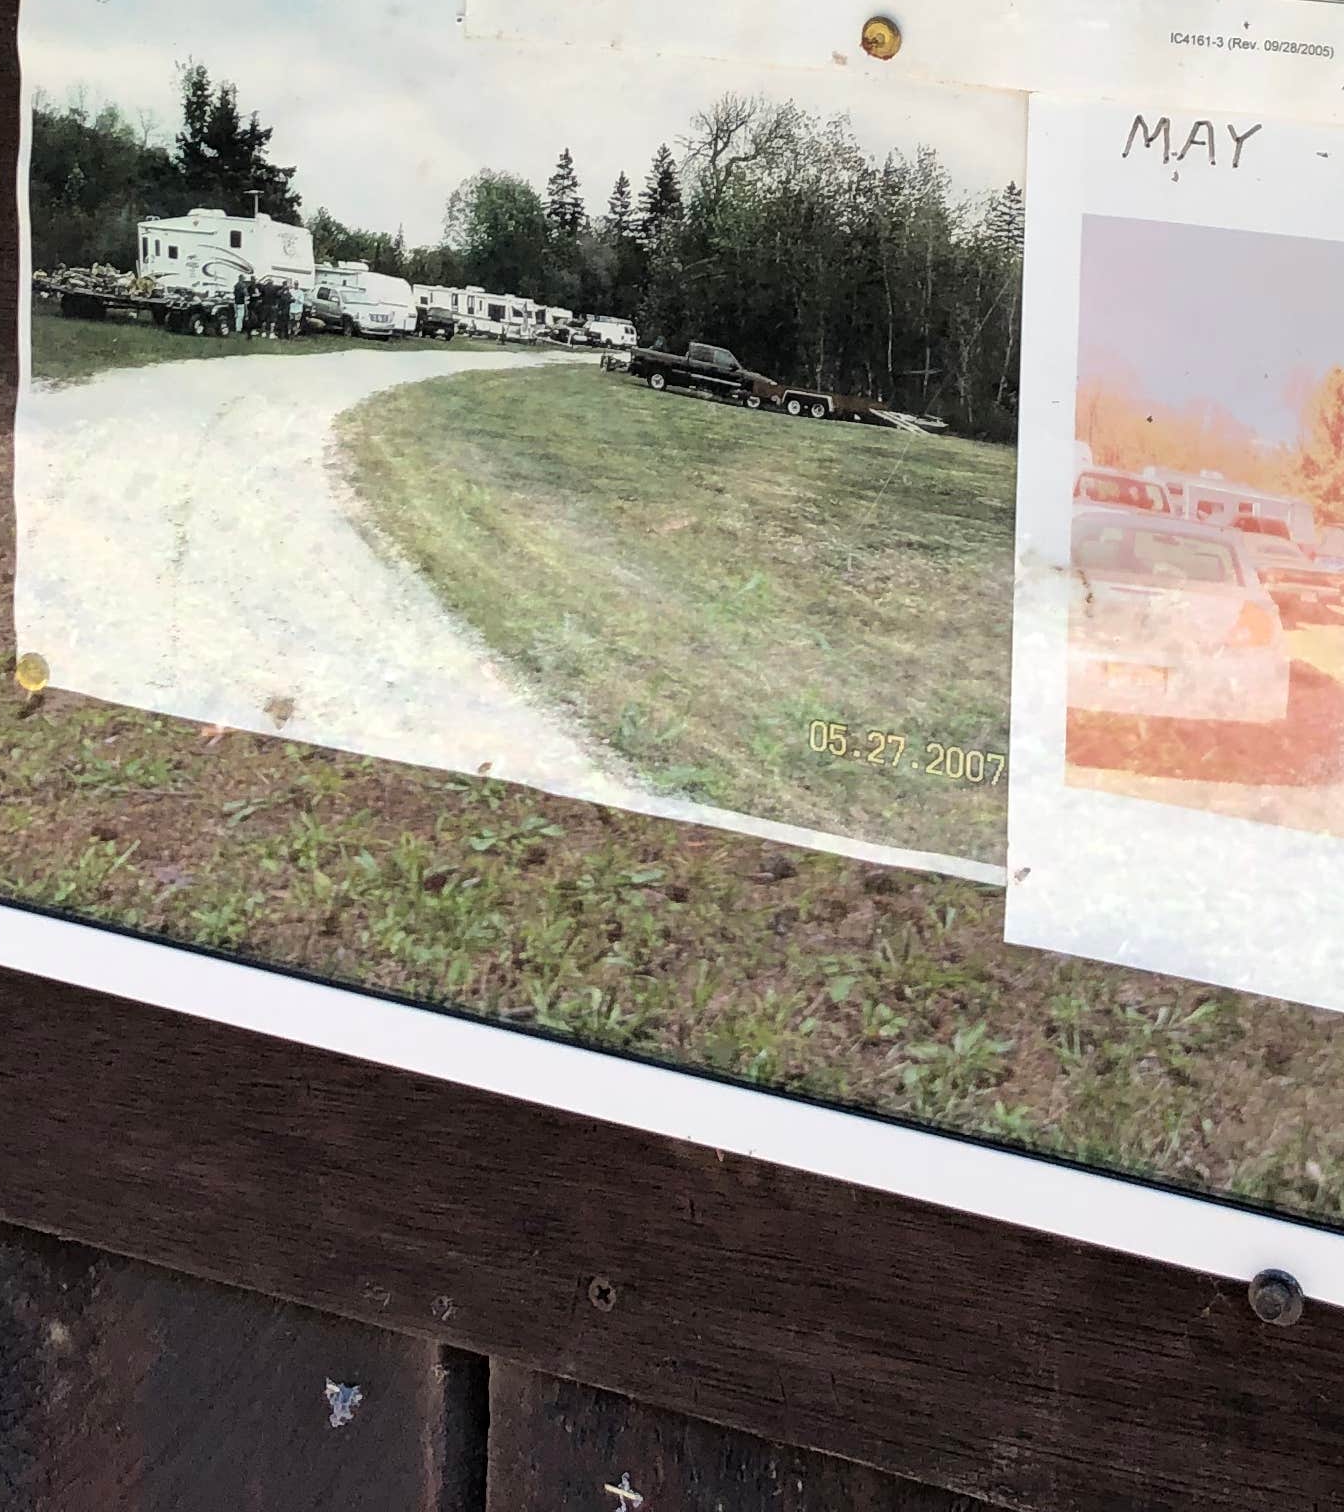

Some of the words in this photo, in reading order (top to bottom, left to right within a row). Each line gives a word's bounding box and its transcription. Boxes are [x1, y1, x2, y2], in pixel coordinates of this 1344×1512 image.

[1170, 32, 1225, 49] IC4161-3
[1227, 37, 1260, 51] (Rev.
[1263, 39, 1335, 60] 09/28/2005)
[810, 720, 1004, 785] 05.27.2007
